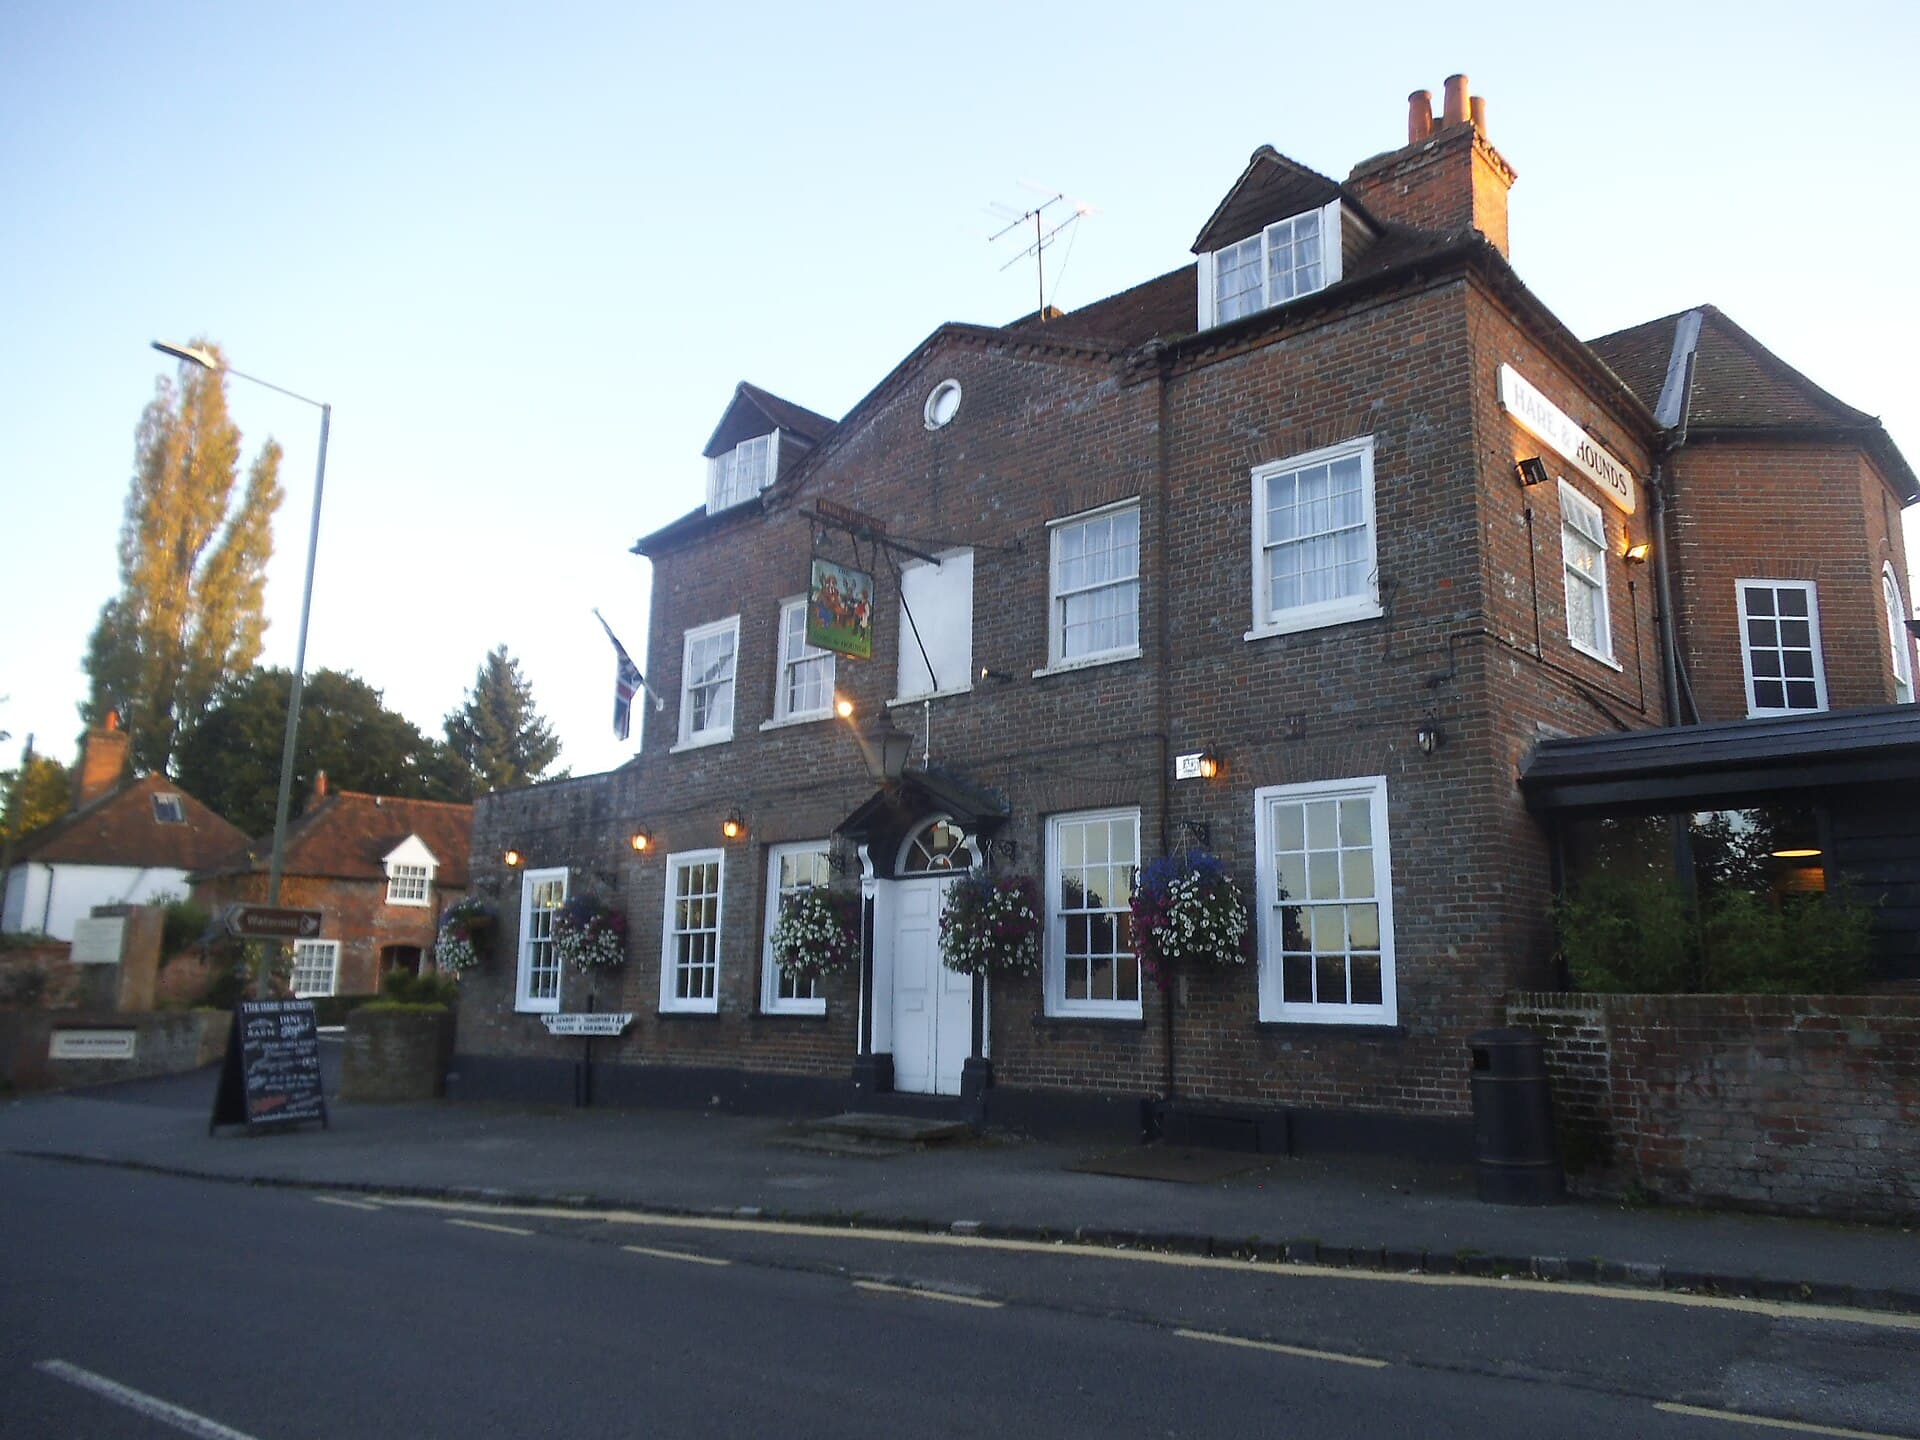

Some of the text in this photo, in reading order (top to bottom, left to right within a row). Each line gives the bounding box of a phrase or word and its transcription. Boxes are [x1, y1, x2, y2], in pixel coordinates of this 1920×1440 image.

[1514, 383, 1557, 437] HARE
[1575, 434, 1627, 497] HOUNDS
[247, 914, 299, 929] Watermill
